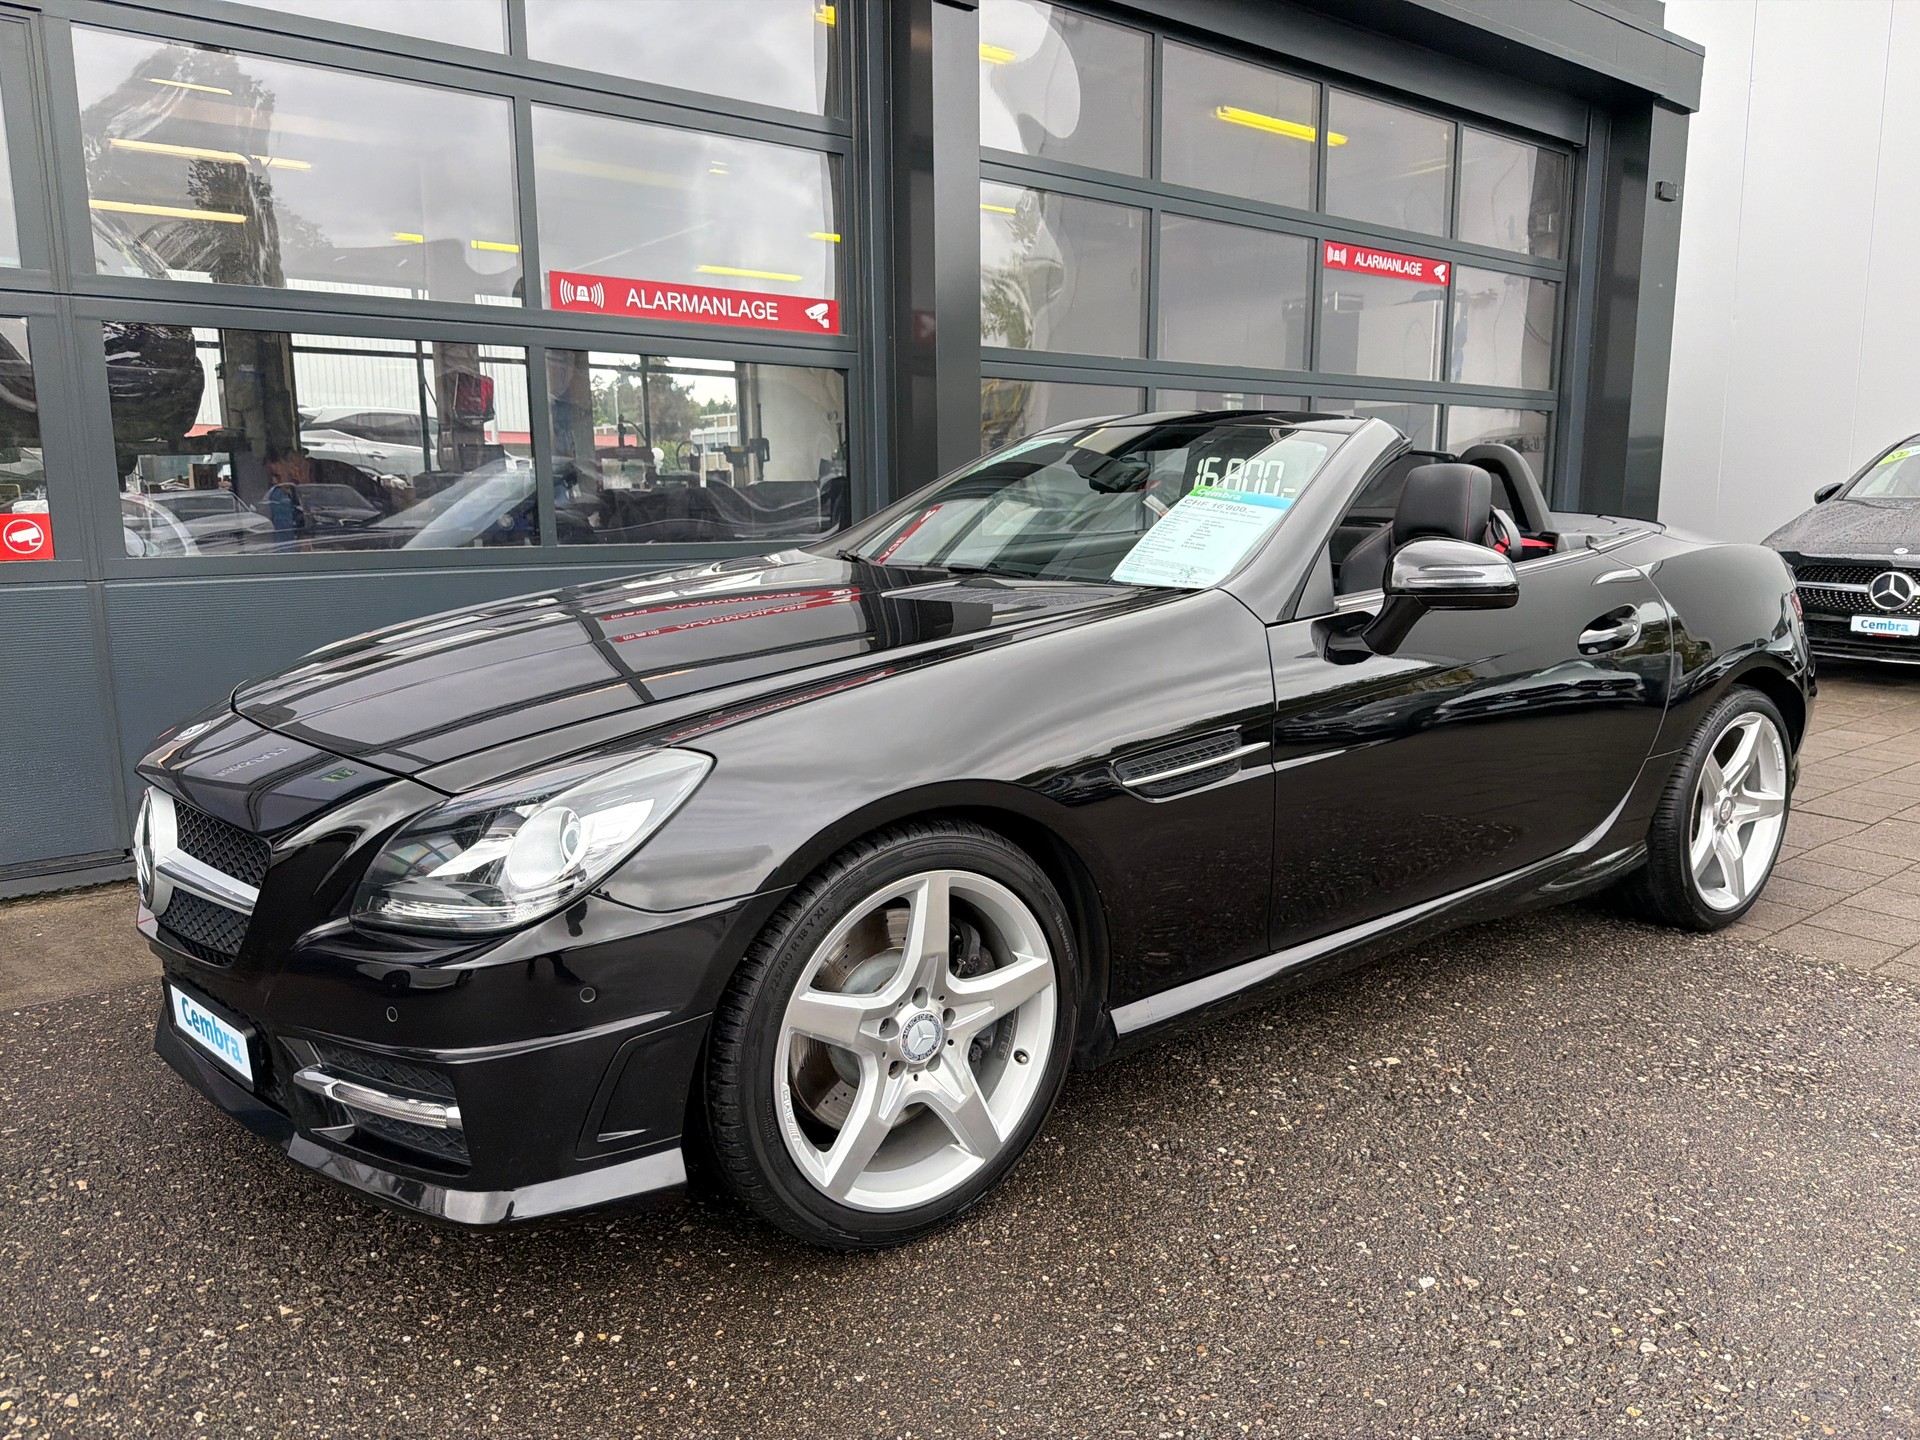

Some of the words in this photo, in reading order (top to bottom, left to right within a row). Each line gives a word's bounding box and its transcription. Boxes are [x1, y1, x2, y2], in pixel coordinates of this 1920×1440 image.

[1354, 252, 1422, 276] ALARMANLAGE
[626, 288, 779, 321] ALARMANLAGE
[1196, 488, 1242, 500] Cembra
[1184, 498, 1209, 506] CHF
[1860, 619, 1909, 632] Cembra
[813, 906, 829, 919] XL
[182, 996, 243, 1065] Cembra
